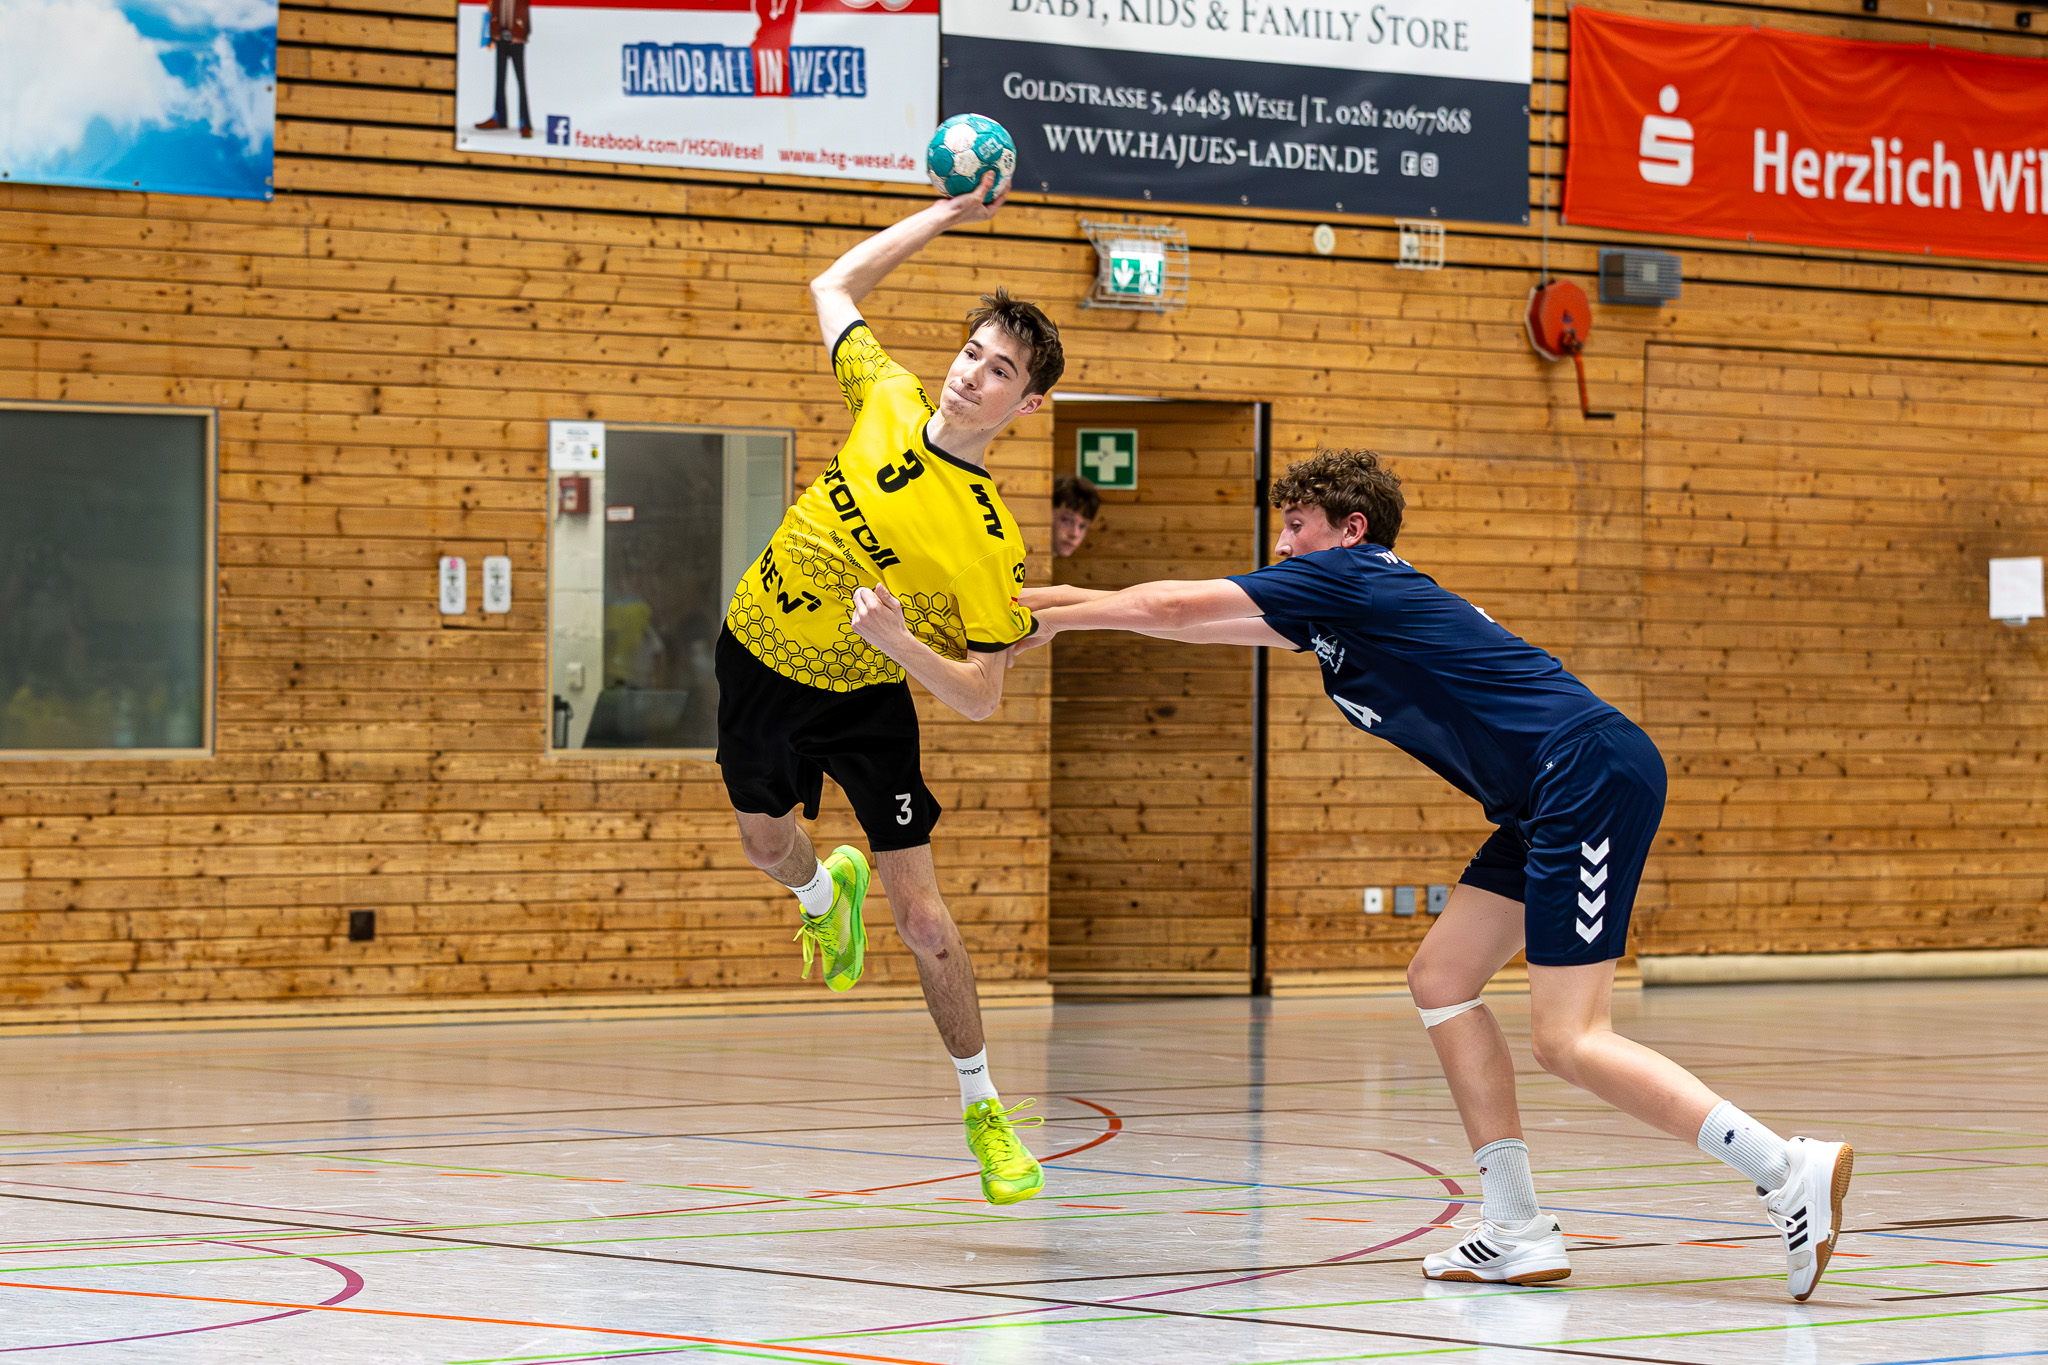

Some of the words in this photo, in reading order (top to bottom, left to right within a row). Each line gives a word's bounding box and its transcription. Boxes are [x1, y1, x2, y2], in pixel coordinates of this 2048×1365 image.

[1119, 0, 1196, 28] KIDS
[1241, 0, 1360, 41] FAMILY
[1367, 4, 1470, 51] STORE
[622, 47, 753, 93] HANDBALL
[757, 48, 784, 94] IN
[790, 49, 866, 95] WESEL
[1002, 71, 1149, 110] GOLDSTRASSE
[1170, 87, 1231, 121] 46483
[1233, 90, 1299, 122] WESEL
[1335, 100, 1379, 128] 0281
[1382, 104, 1472, 137] 20677868
[574, 129, 764, 161] facebook.com/HSGWesel
[778, 148, 916, 172] www.hsg-wesel.de
[1041, 123, 1380, 176] WWW.HAJUES-LADEN.DE
[1752, 127, 1962, 210] Herzlich
[876, 448, 925, 493] 3
[968, 483, 1005, 541] WTV
[828, 529, 846, 550] mehr
[760, 543, 806, 615] BEW
[1333, 693, 1382, 729] 4
[895, 793, 913, 826] 3
